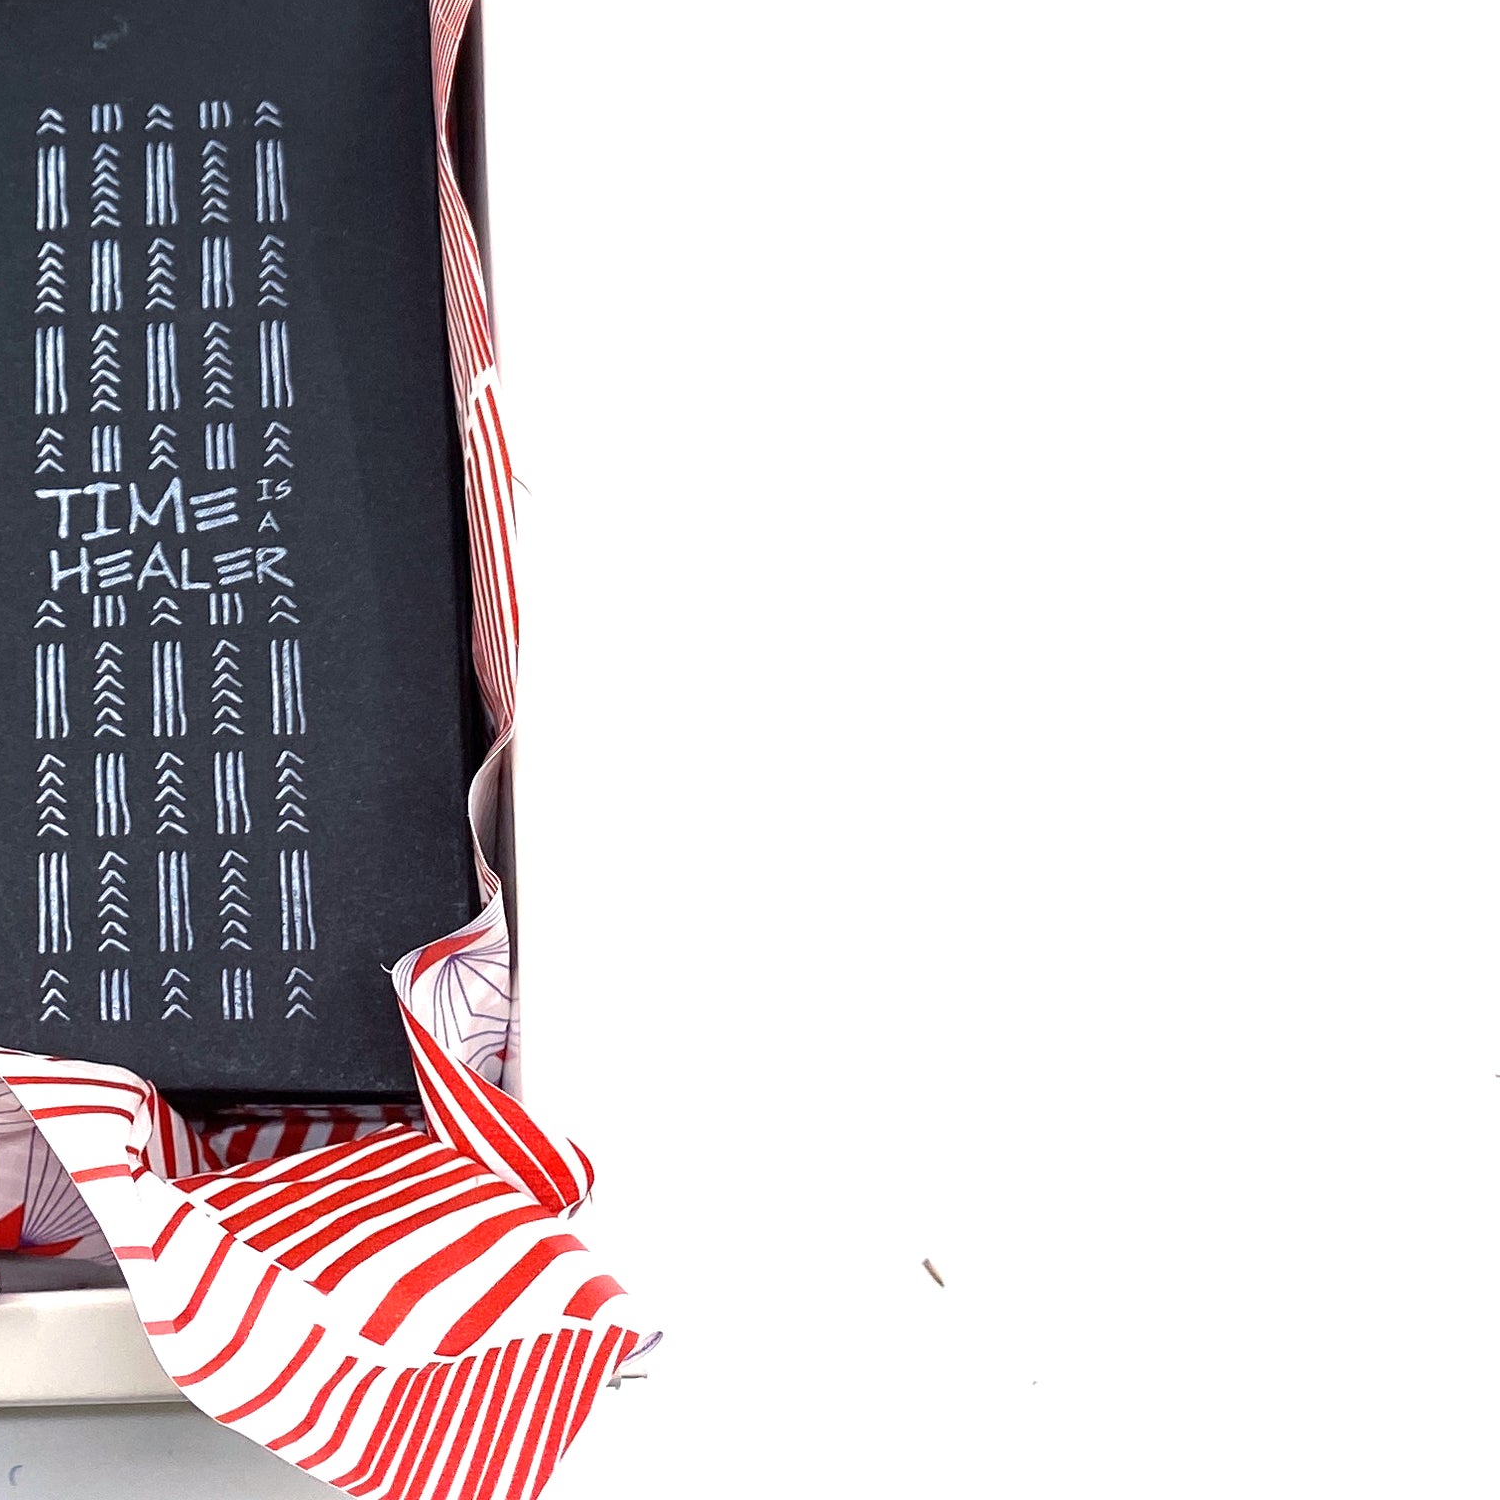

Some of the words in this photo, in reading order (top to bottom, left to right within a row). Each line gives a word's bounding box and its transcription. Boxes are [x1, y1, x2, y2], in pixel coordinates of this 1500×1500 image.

[34, 476, 240, 542] TIME
[256, 478, 293, 502] IS
[257, 510, 281, 534] A
[49, 541, 295, 594] HEALER
